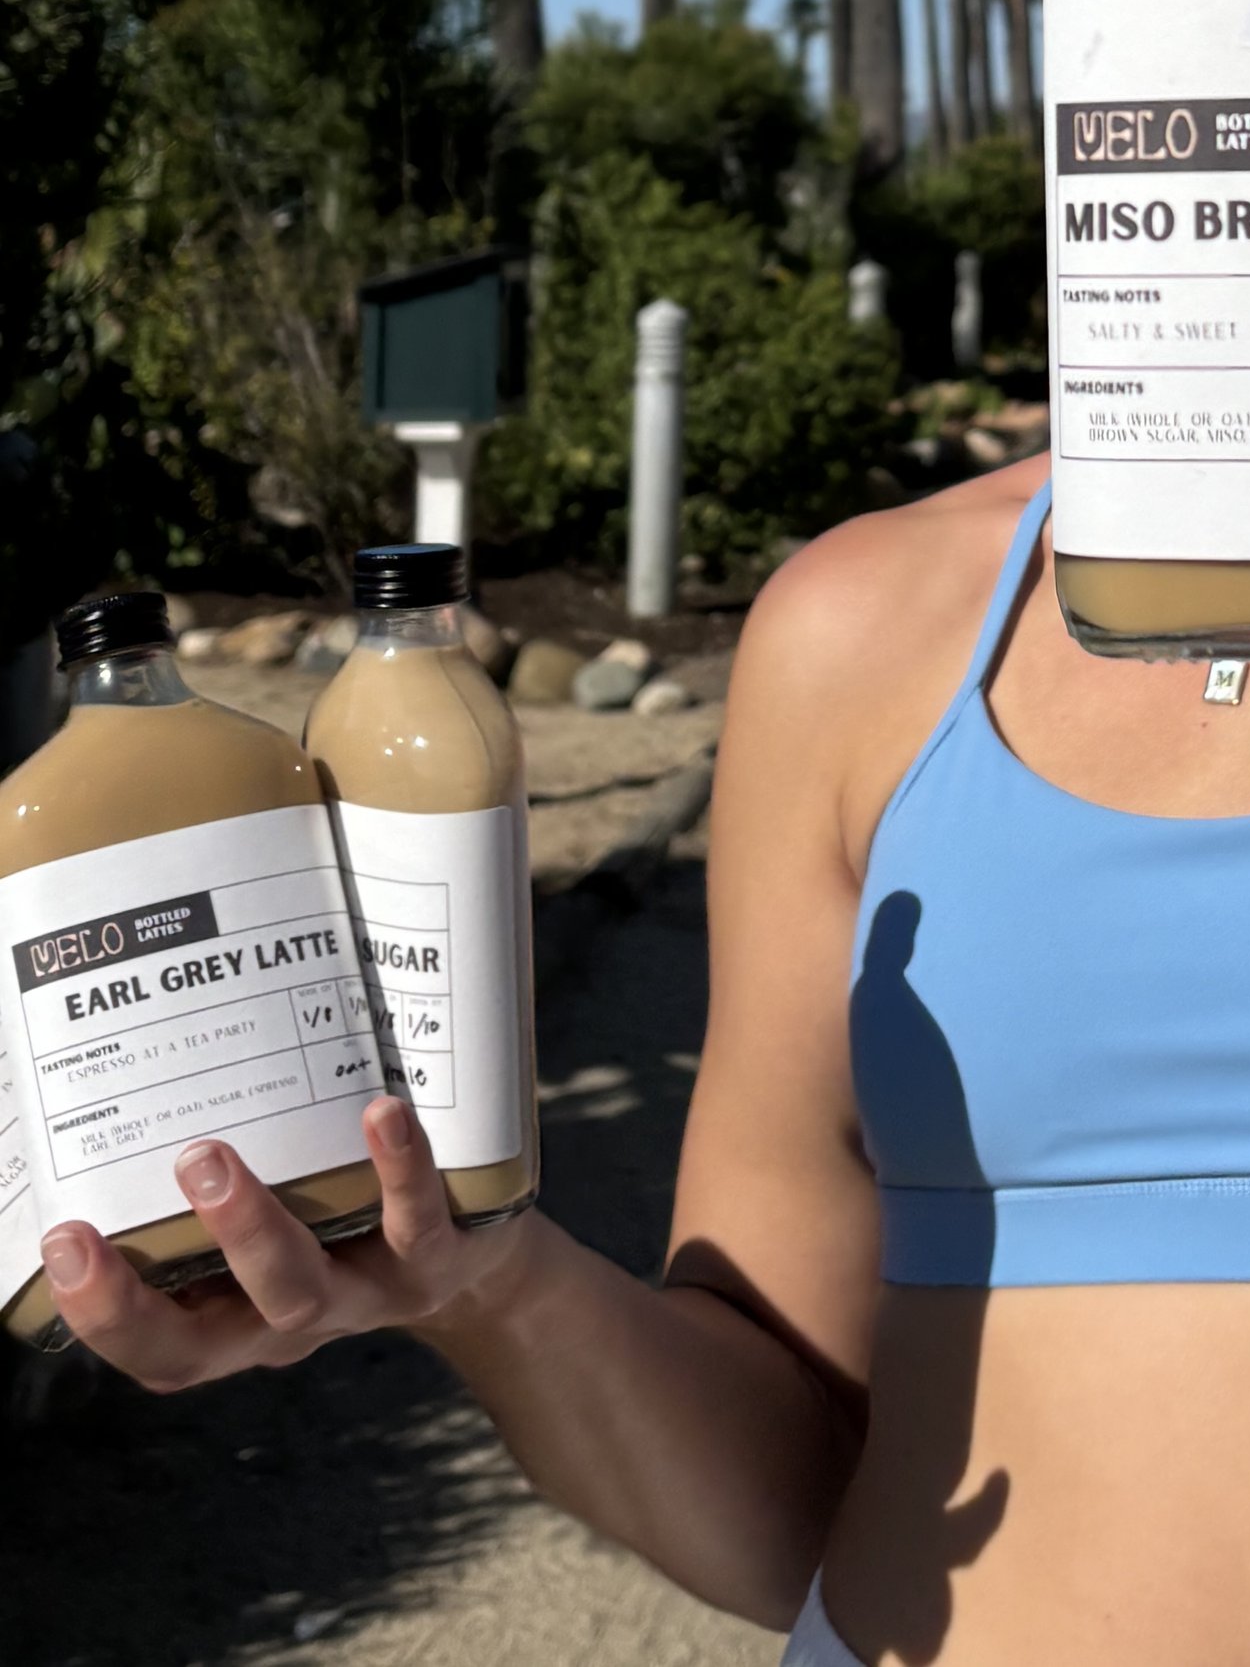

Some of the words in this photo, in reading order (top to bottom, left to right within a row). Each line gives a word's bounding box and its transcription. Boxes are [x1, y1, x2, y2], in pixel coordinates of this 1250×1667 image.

[1065, 200, 1175, 242] MISO
[1063, 289, 1110, 303] TASTING
[1113, 289, 1161, 303] NOTES
[1088, 321, 1141, 341] SALTY
[1152, 321, 1164, 340] &
[1174, 320, 1237, 341] SWEET
[1063, 380, 1145, 395] INGREDIENTS
[1190, 411, 1215, 427] OR
[1089, 428, 1140, 442] BROWN
[134, 907, 191, 931] BOTTLED
[137, 922, 184, 942] LATTES
[362, 938, 441, 973] SUGAR
[65, 976, 151, 1021] EARL
[160, 948, 243, 992] GREY
[254, 929, 339, 970] LATTE
[408, 1013, 441, 1039] 1/10
[41, 1051, 84, 1075] TASTING
[86, 1042, 122, 1061] NOTES
[67, 1053, 136, 1083] ESPRESSO
[143, 1045, 160, 1060] AT
[184, 1031, 209, 1049] TEA
[214, 1019, 257, 1041] PARTY
[335, 1057, 372, 1078] oat
[53, 1105, 120, 1135] INGREDIENTS
[156, 1109, 173, 1123] OR
